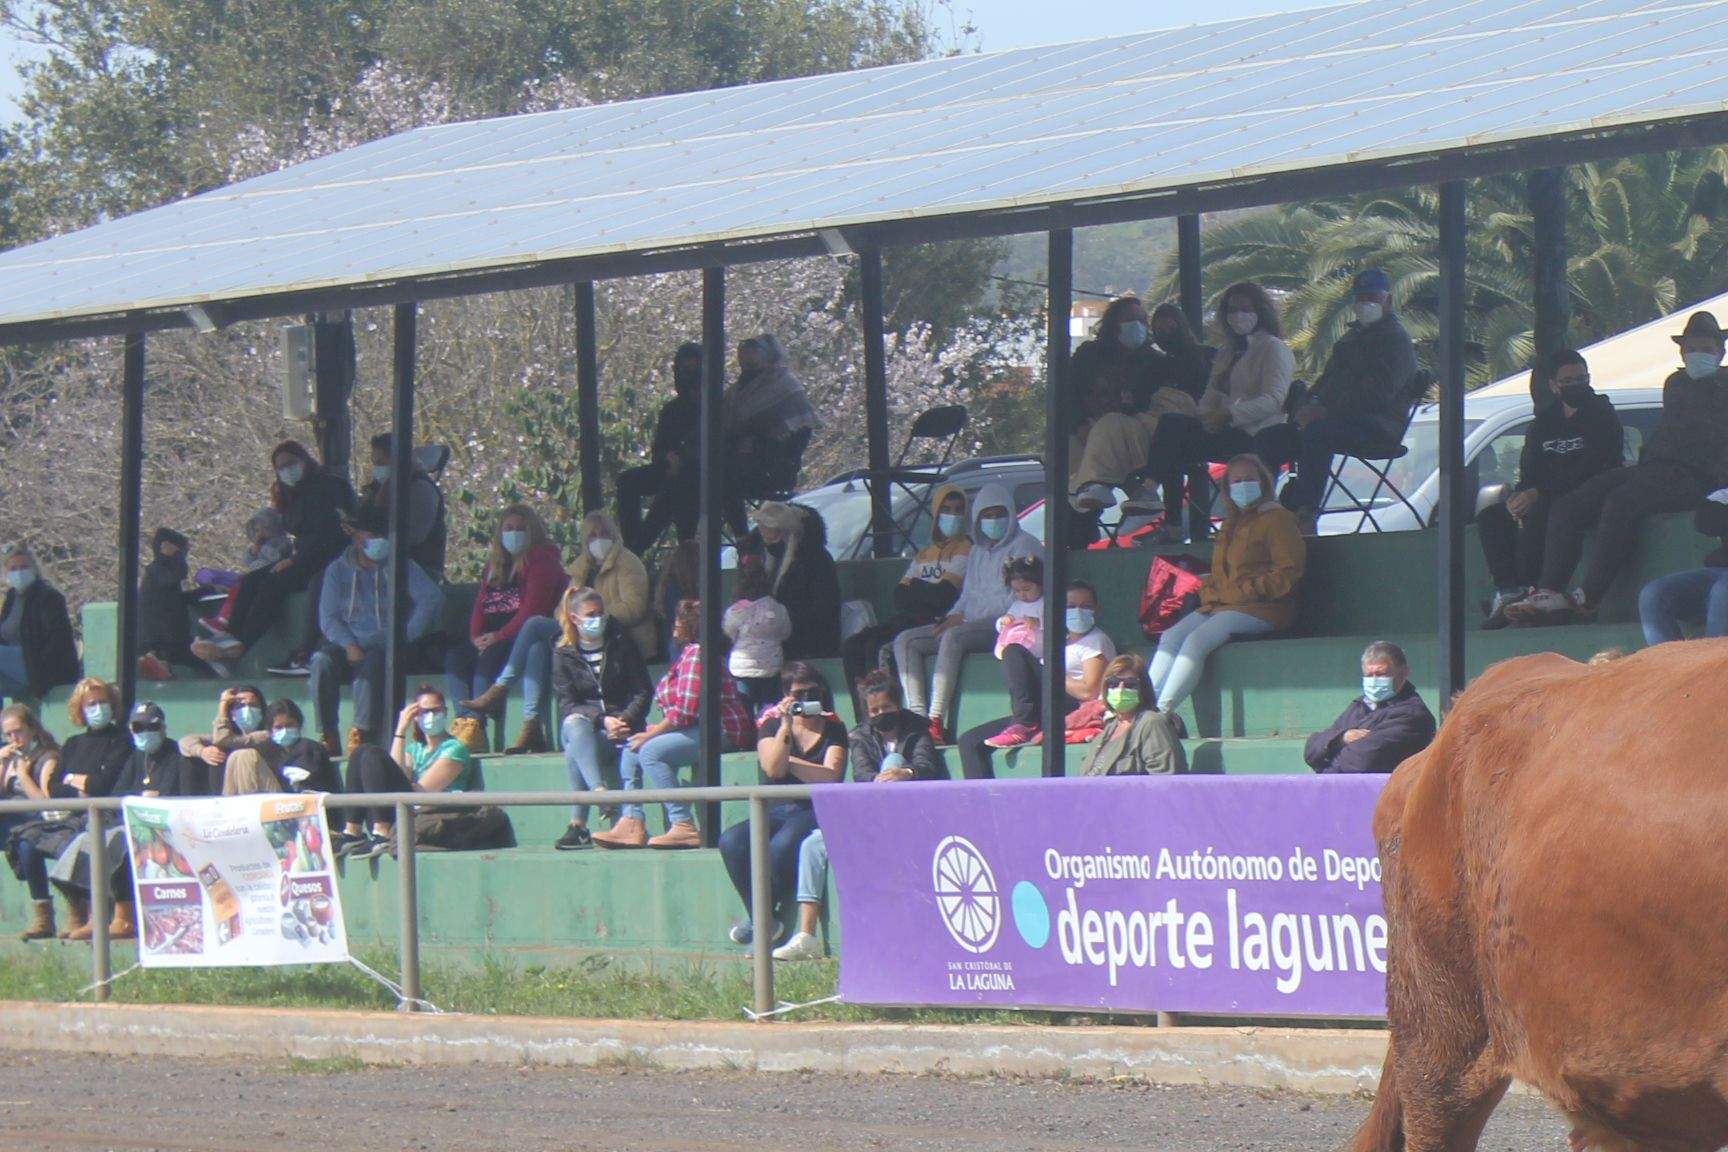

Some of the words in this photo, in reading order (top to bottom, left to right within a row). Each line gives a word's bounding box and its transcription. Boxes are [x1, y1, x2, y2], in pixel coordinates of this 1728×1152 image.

[1044, 846, 1151, 888] Organismo
[1155, 846, 1283, 881] Autónomo
[1288, 846, 1318, 881] de
[153, 886, 188, 900] Carnes
[290, 880, 323, 896] Quesos
[1057, 887, 1215, 987] deporte
[1227, 888, 1388, 995] lagune
[948, 961, 962, 971] SAN
[1003, 961, 1013, 971] DE
[949, 973, 966, 990] LA
[967, 973, 1016, 991] LAGUNA
